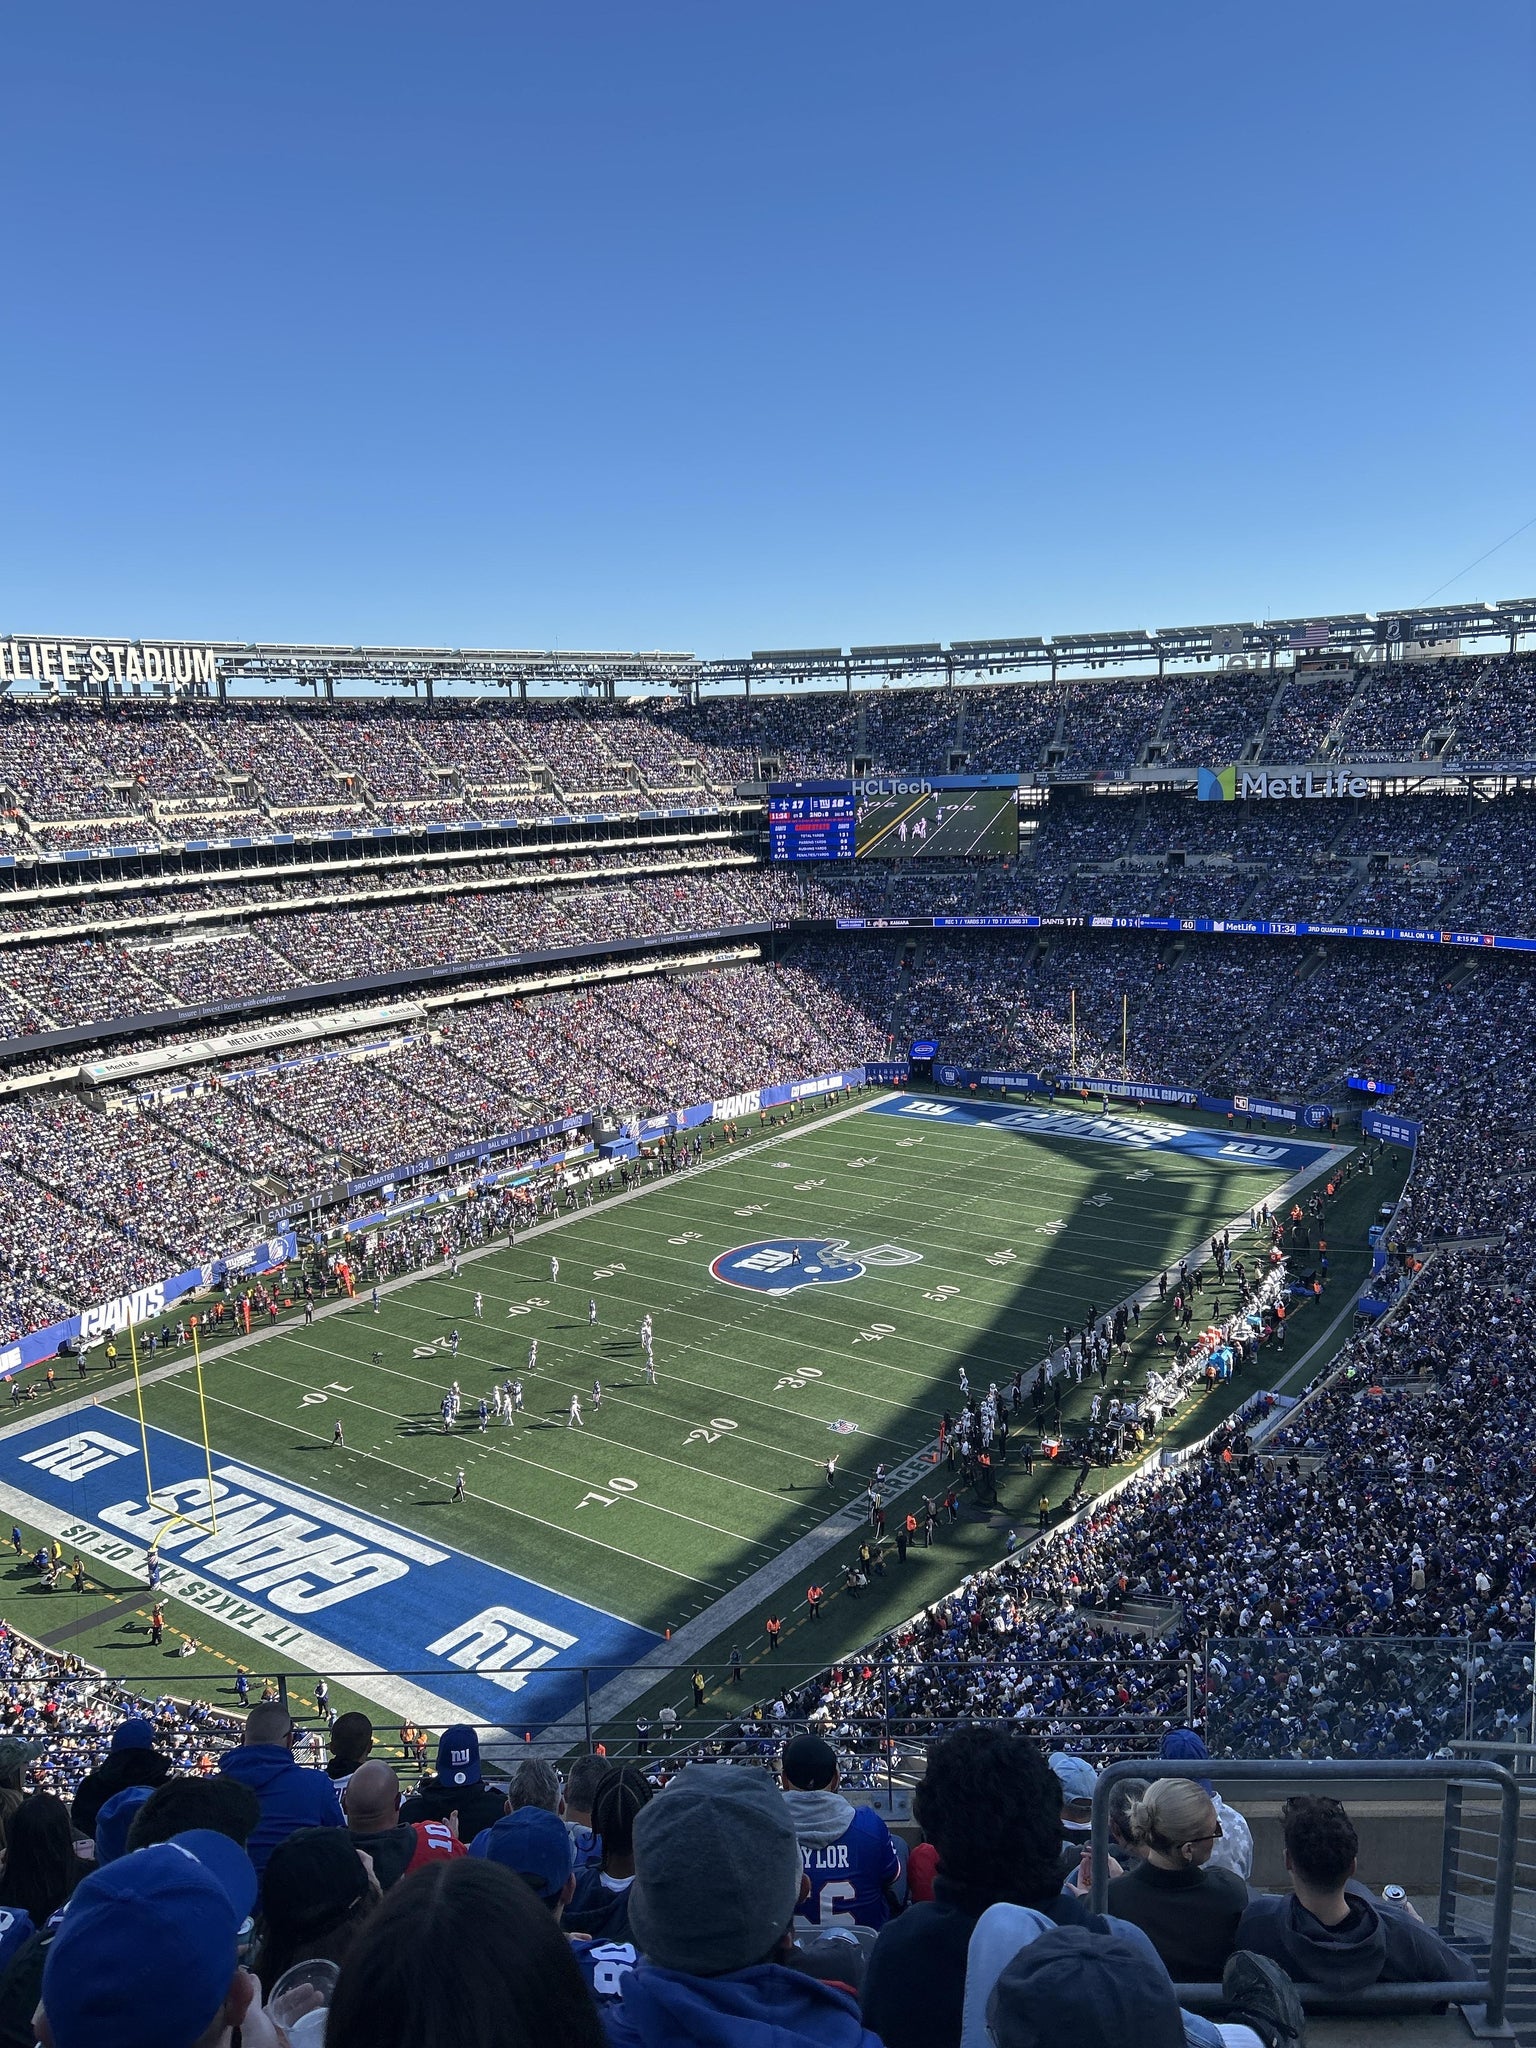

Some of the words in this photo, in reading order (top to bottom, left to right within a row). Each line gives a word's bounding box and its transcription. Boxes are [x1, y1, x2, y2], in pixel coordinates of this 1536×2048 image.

[90, 645, 216, 683] STADIUM
[852, 780, 932, 796] HCLTech
[1241, 769, 1368, 800] MetLife
[1066, 918, 1076, 926] 17
[1092, 918, 1114, 926] GIANTS
[1182, 920, 1194, 929] 40
[1226, 923, 1256, 931] MetLife
[1271, 924, 1295, 933] 11:34
[699, 930, 721, 939] confidence
[432, 967, 449, 976] Insure
[469, 963, 484, 971] Retire
[496, 957, 522, 966] confidence
[178, 1010, 198, 1019] Insure
[202, 1006, 220, 1015] Invest
[224, 1002, 242, 1011] Retire
[255, 994, 287, 1006] confidence
[388, 1005, 416, 1016] MetLife
[227, 1033, 265, 1047] METLIFE
[266, 1026, 302, 1040] STADIUM
[105, 1060, 140, 1072] MetLife
[1084, 1082, 1110, 1094] YORK
[1111, 1085, 1160, 1099] FOOTBALL
[712, 1090, 760, 1120] GIANTS
[898, 1101, 960, 1116] ny
[1236, 1098, 1246, 1108] 40
[544, 1127, 554, 1135] 10
[562, 1115, 583, 1131] GIANTS
[988, 1112, 1187, 1146] GIANTS
[488, 1141, 500, 1149] BALL
[895, 1136, 925, 1147] 10
[454, 1151, 466, 1160] 2ND
[1218, 1141, 1291, 1160] ny
[405, 1160, 429, 1176] 11:34
[436, 1156, 446, 1166] 40
[353, 1182, 367, 1192] 3RD
[367, 1173, 395, 1187] QUARTER
[1126, 1170, 1154, 1182] 10
[793, 1180, 824, 1191] 30
[268, 1201, 304, 1222] SAINTS
[310, 1195, 322, 1208] 17
[1082, 1194, 1114, 1207] 20
[733, 1204, 763, 1217] 40
[1035, 1221, 1068, 1235] 30
[667, 1231, 703, 1245] 50
[731, 1248, 794, 1273] ny
[985, 1252, 1017, 1266] 40
[593, 1262, 627, 1278] 40
[922, 1285, 960, 1302] 50
[80, 1282, 165, 1338] GIANTS
[509, 1298, 550, 1314] 30
[860, 1323, 896, 1341] 40
[778, 1367, 823, 1389] 30
[302, 1381, 354, 1404] 10
[689, 1418, 738, 1444] 20
[18, 1430, 140, 1482] ny
[582, 1477, 638, 1508] 10
[60, 1525, 100, 1545] US
[92, 1542, 134, 1561] OF
[98, 1478, 410, 1614] GIANTS
[179, 1582, 266, 1630] TAKES
[262, 1626, 304, 1648] IT
[425, 1606, 579, 1692] ny
[451, 1748, 469, 1766] ny
[424, 1824, 452, 1853] 10
[801, 1845, 850, 1869] YLOR
[589, 1942, 637, 1997] 80
